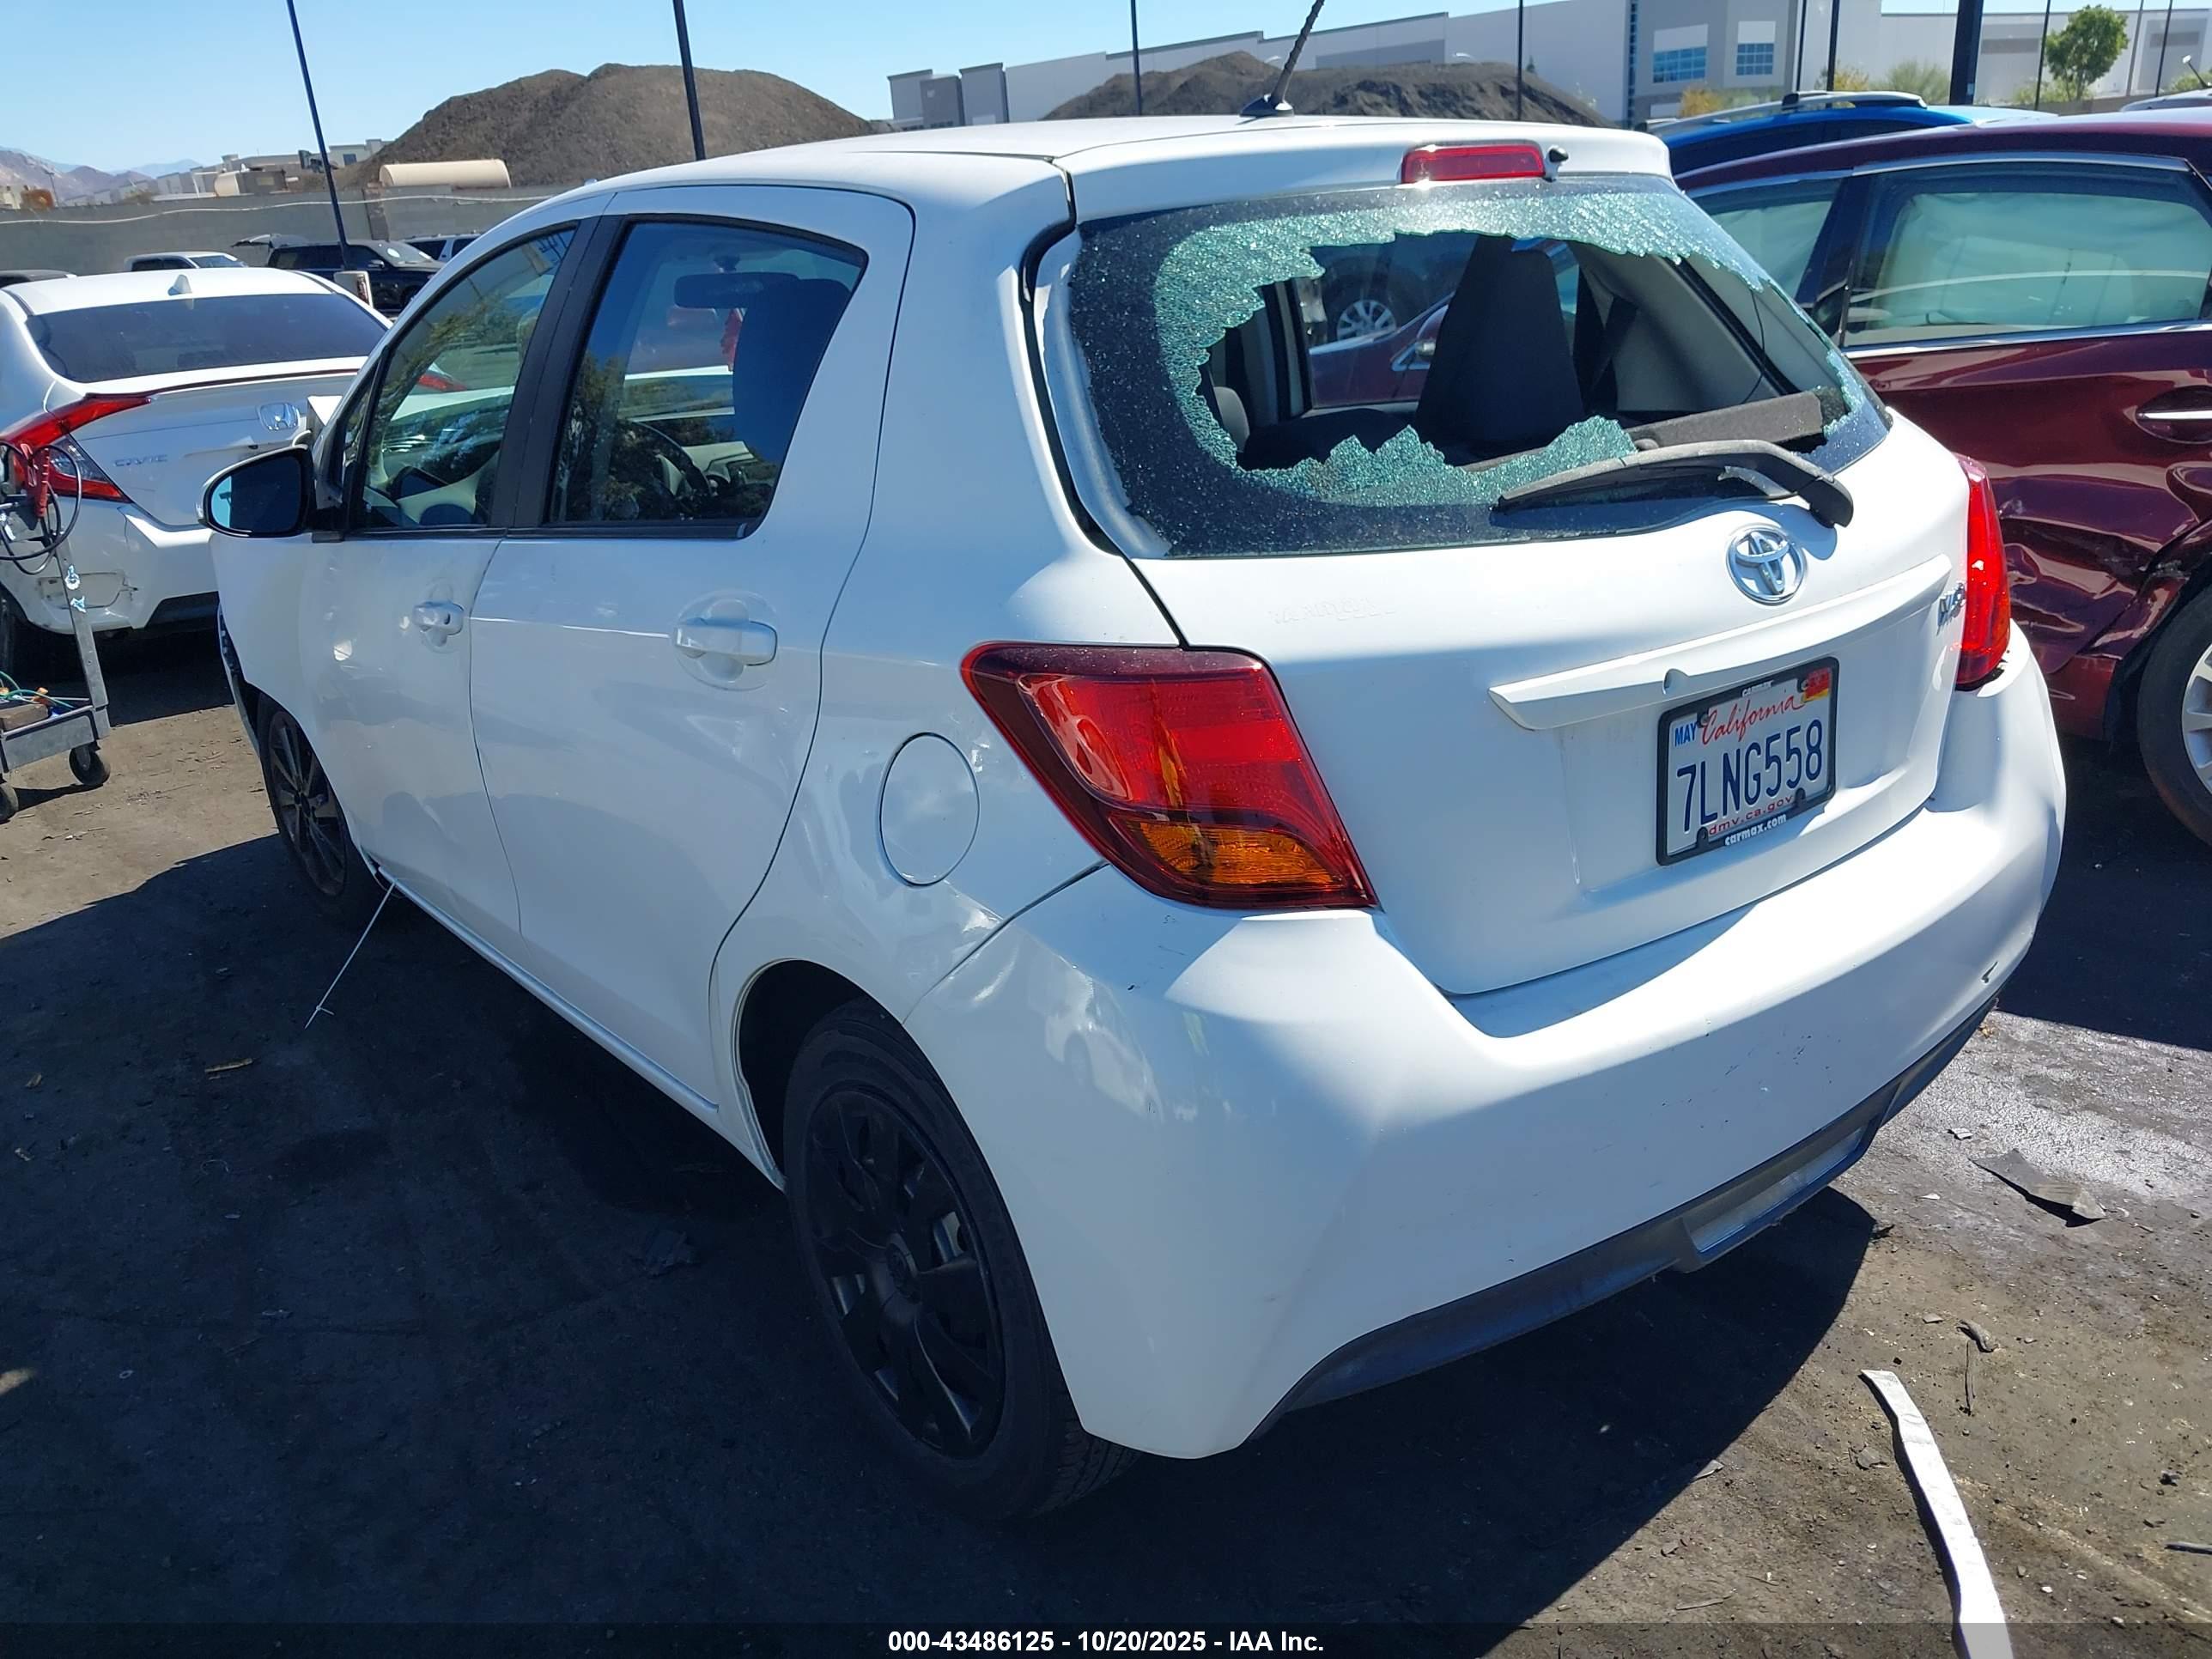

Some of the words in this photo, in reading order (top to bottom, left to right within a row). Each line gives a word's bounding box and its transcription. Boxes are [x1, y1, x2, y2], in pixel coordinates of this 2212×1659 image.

[1674, 722, 1698, 747] MAY
[1701, 693, 1806, 745] California
[1676, 719, 1823, 833] 7LNG558
[1709, 794, 1794, 836] dmv.ca.gov
[1724, 813, 1787, 847] carmax.com
